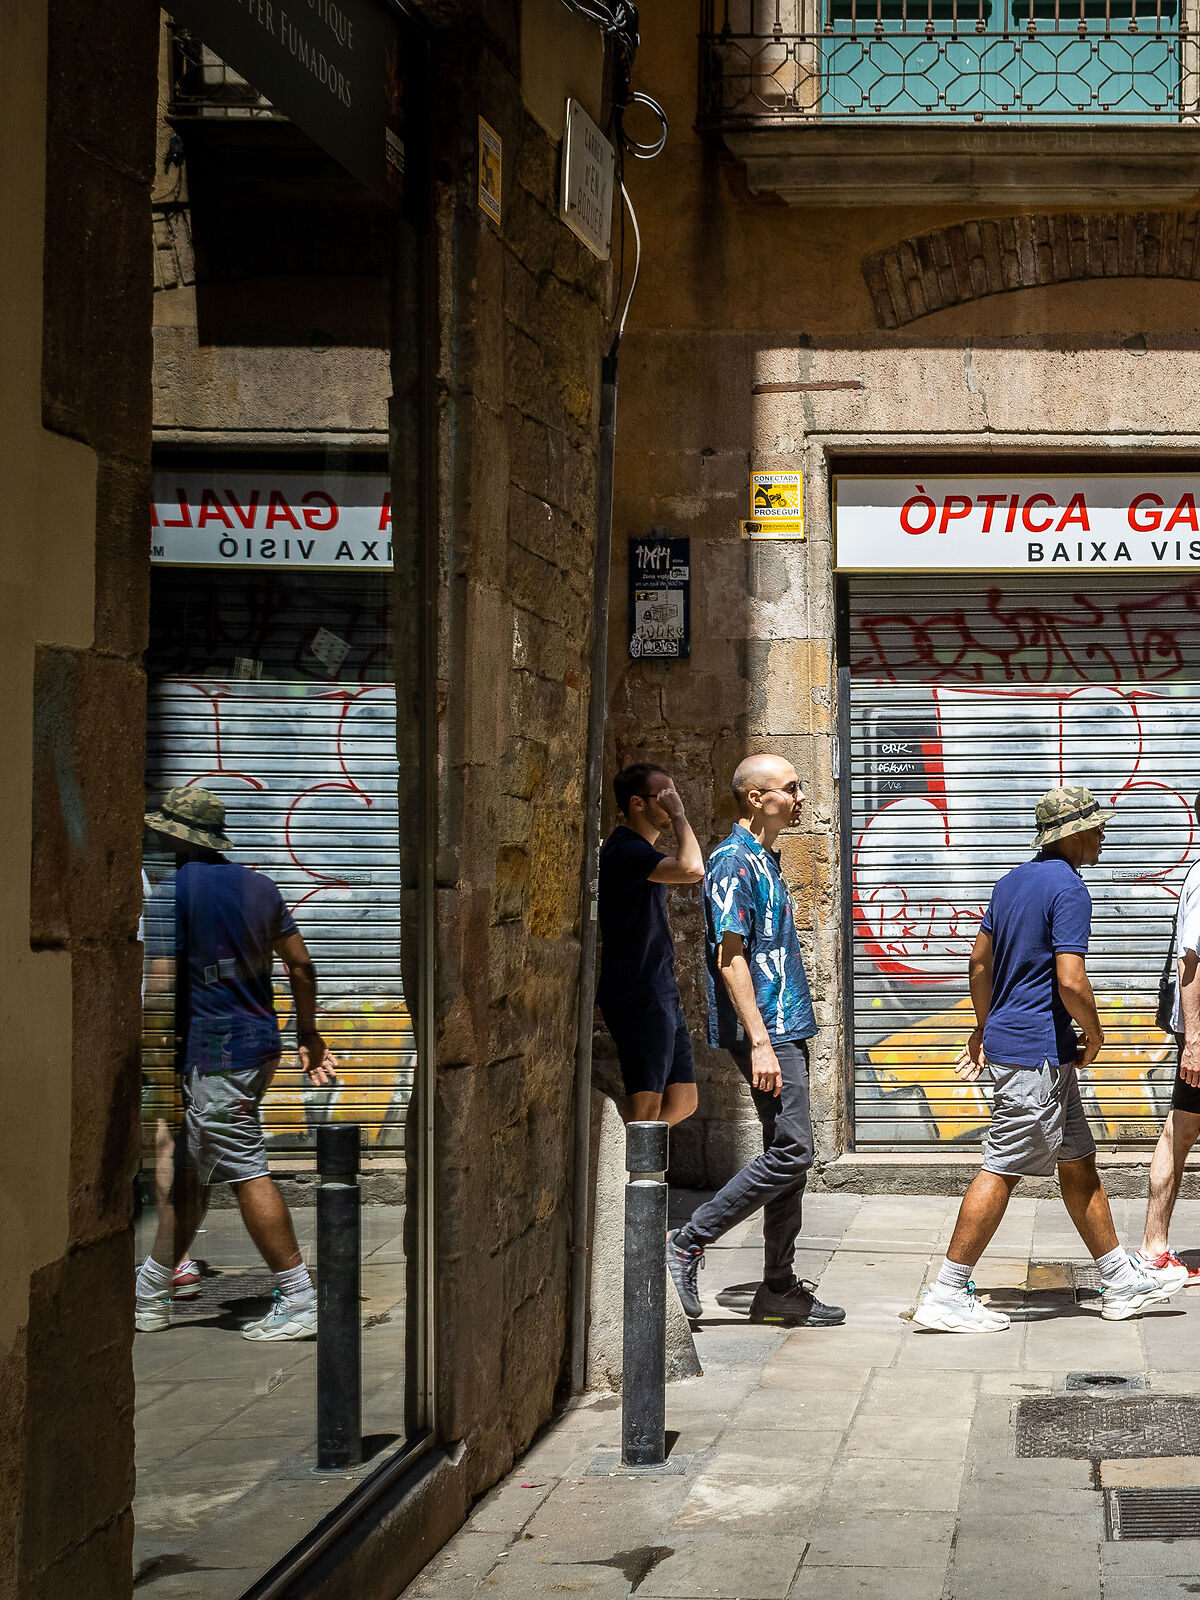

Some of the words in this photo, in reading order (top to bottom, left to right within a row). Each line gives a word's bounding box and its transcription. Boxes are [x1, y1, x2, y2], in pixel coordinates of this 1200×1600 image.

[307, 0, 353, 49] TIQUE
[280, 8, 352, 108] FUMADORS
[754, 508, 799, 516] PROSEGUR
[899, 485, 1091, 536] ÒPTICA
[1027, 541, 1132, 562] BAIXA
